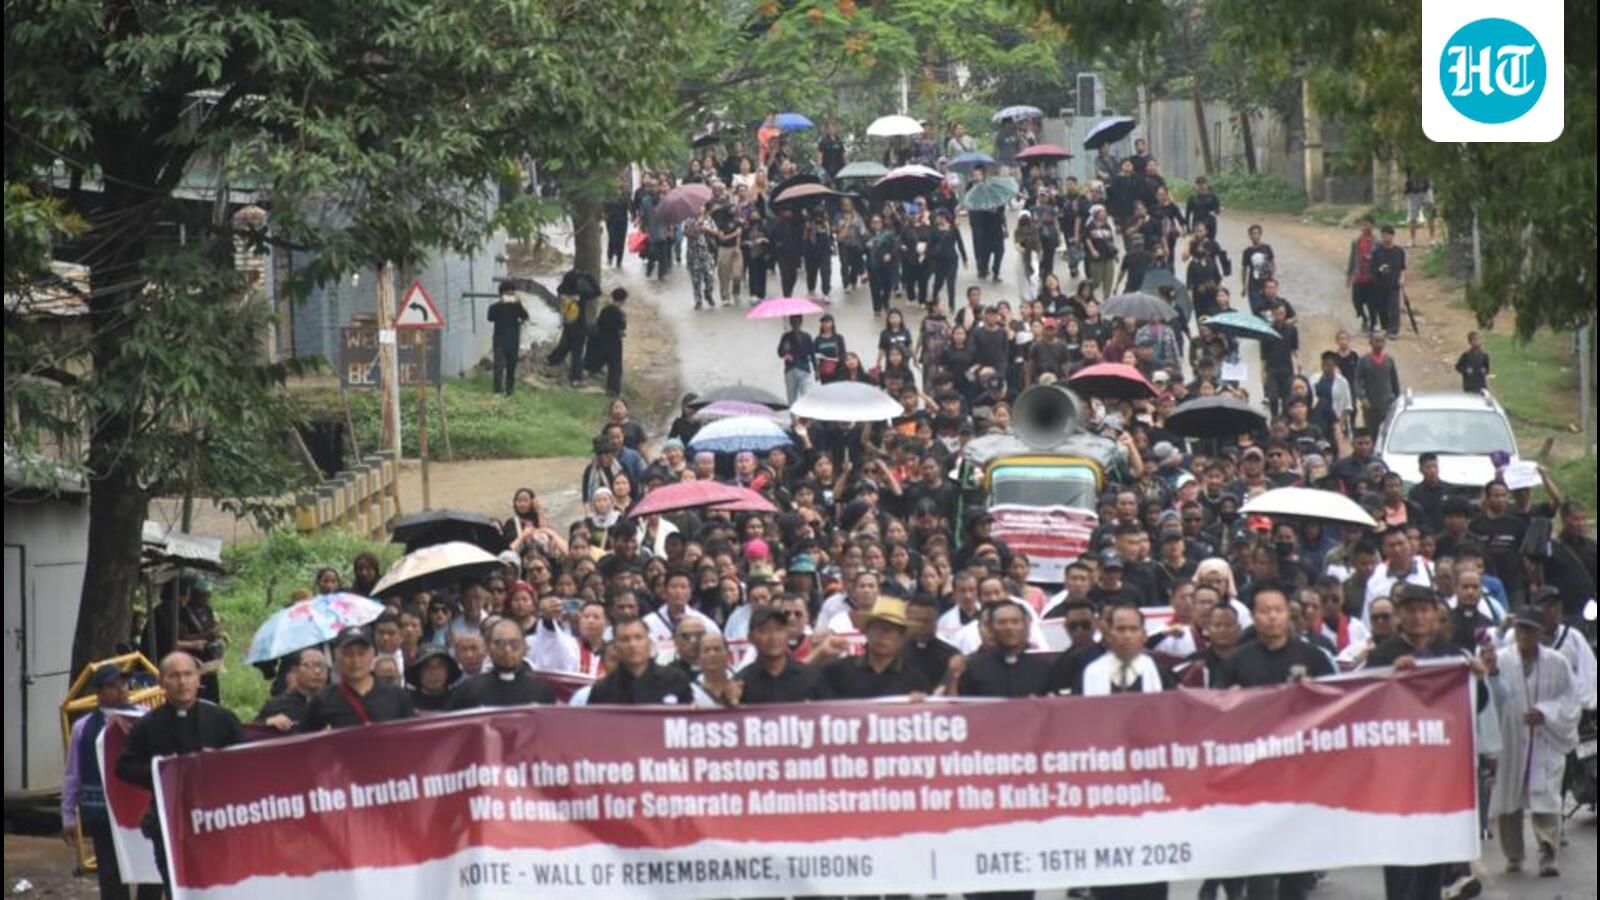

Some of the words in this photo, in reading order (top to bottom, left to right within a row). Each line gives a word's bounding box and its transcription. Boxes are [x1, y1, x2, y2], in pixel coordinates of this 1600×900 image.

[663, 716, 739, 749] Mass
[743, 715, 815, 749] Rally
[819, 713, 861, 745] for
[867, 711, 968, 744] Justice
[191, 795, 305, 834] Protesting
[309, 787, 347, 813] the
[350, 774, 419, 808] brutal
[423, 763, 500, 798] murder
[504, 762, 528, 788] of
[532, 760, 569, 787] the
[573, 758, 634, 786] three
[639, 756, 690, 783] Kuki
[694, 756, 780, 783] Pastors
[784, 754, 827, 781] and
[831, 753, 869, 780] the
[873, 754, 936, 780] proxy
[940, 750, 1038, 777] violence
[1042, 746, 1126, 775] carried
[1129, 745, 1167, 771] out
[1170, 741, 1199, 770] by
[1352, 719, 1451, 748] NSCN-IM.
[470, 795, 506, 821] We
[510, 795, 599, 822] demand
[603, 793, 637, 820] for
[641, 791, 743, 819] Separate
[748, 786, 917, 816] Administration
[920, 784, 954, 811] for
[957, 783, 994, 811] the
[998, 781, 1083, 811] Kuki-Zo
[1086, 779, 1172, 809] people.
[533, 862, 585, 886] WALL
[592, 863, 616, 885] OF
[622, 856, 781, 886] REMEMBRANCE,
[786, 854, 873, 879] TUIBONG
[976, 852, 1032, 875] DATE:
[1038, 849, 1087, 872] 16TH
[1095, 846, 1135, 869] MAY
[1141, 842, 1192, 866] 2026
